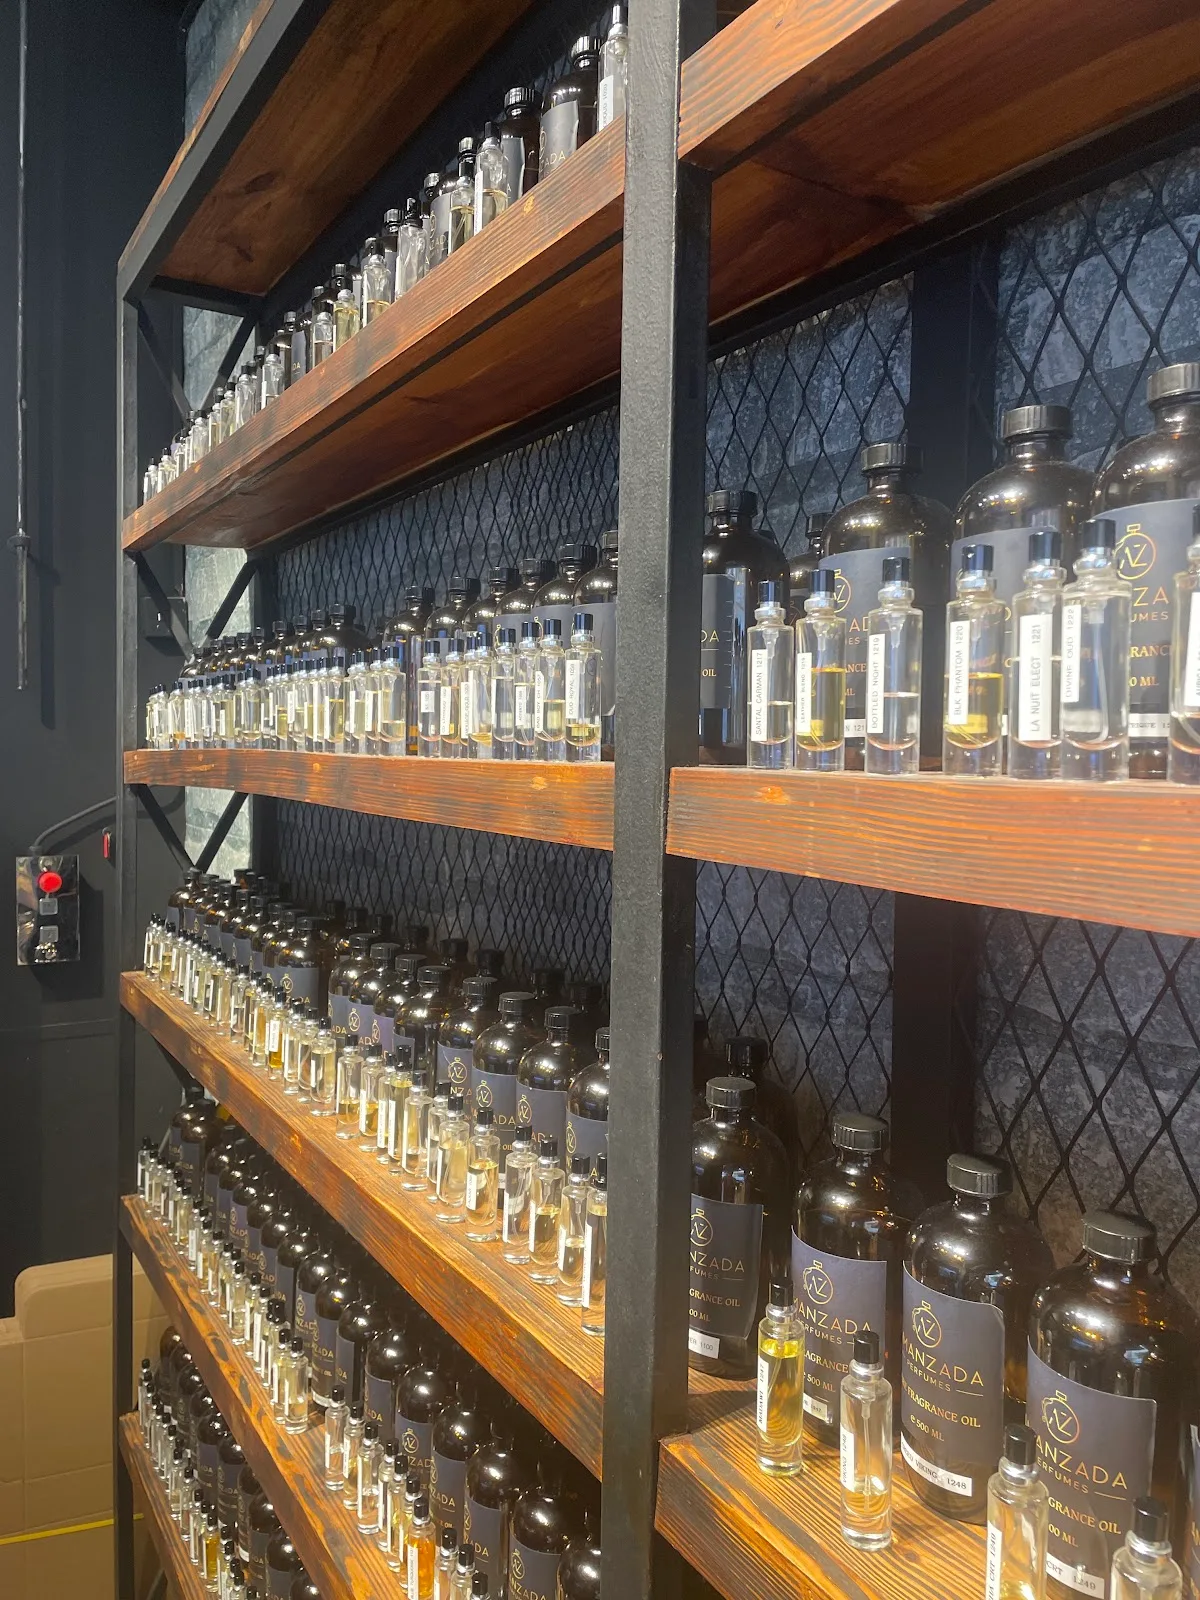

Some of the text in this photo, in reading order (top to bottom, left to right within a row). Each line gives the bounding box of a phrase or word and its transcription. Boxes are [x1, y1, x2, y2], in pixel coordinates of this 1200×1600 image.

[702, 668, 717, 677] OIL
[955, 650, 963, 694] PHANTOM
[1031, 624, 1042, 732] LA NUIT ELECT 1221
[1140, 676, 1159, 687] ML
[871, 690, 879, 729] BOTTLED
[953, 698, 961, 716] BLK
[853, 724, 865, 732] 121
[690, 1250, 745, 1273] NZADA
[690, 1265, 719, 1281] FUMES
[689, 1288, 741, 1307] GRANCE OIL
[689, 1308, 711, 1322] 00 ML
[795, 1300, 872, 1335] ANZADA
[700, 1342, 714, 1351] 1100
[804, 1350, 849, 1374] AGRANCE
[902, 1331, 984, 1387] MANZADA
[807, 1375, 836, 1393] 500 ML
[906, 1359, 951, 1392] PERFUMES
[907, 1387, 981, 1428] FRAGRANCE OIL
[916, 1420, 930, 1434] 500
[931, 1428, 945, 1442] ML
[1036, 1434, 1128, 1490] ANZADA
[915, 1459, 938, 1479] VIKING
[947, 1478, 967, 1490] 1248
[1037, 1456, 1089, 1494] ERFUMES
[1048, 1496, 1122, 1535] GRANCE OIL
[1048, 1523, 1079, 1548] 00 ML
[1046, 1560, 1063, 1576] CRT
